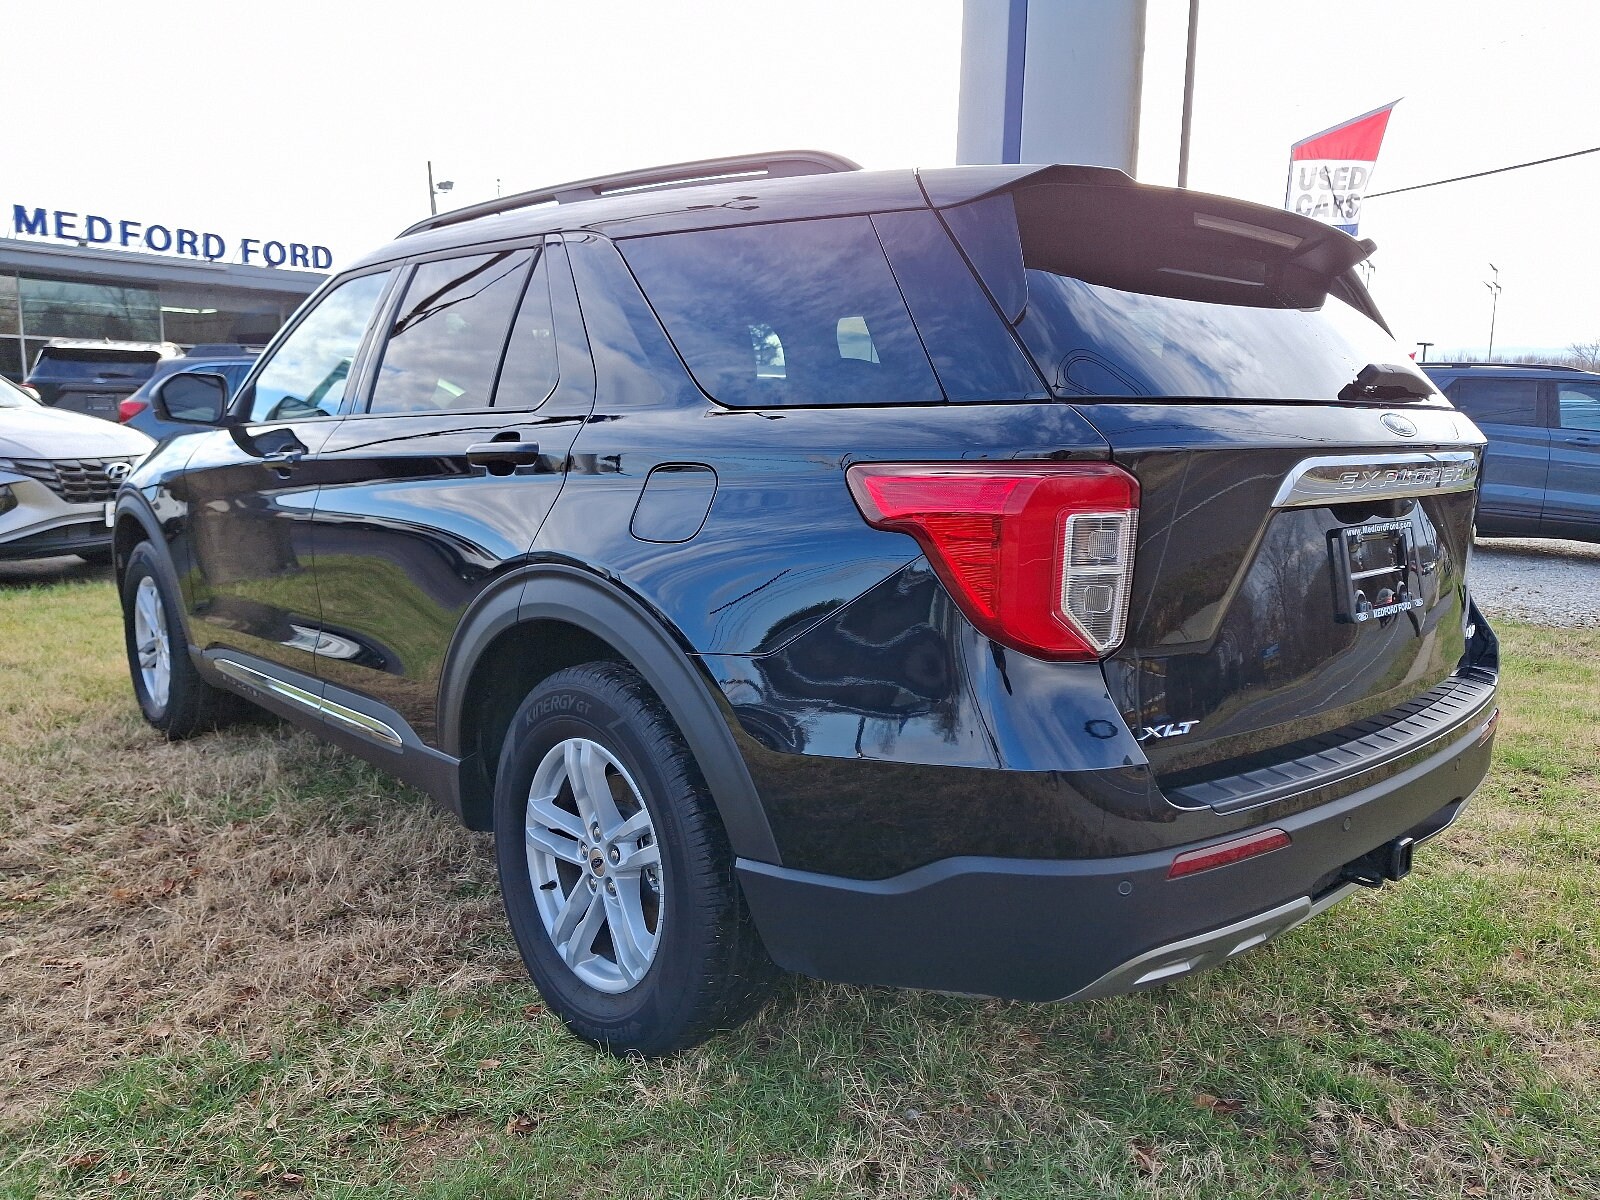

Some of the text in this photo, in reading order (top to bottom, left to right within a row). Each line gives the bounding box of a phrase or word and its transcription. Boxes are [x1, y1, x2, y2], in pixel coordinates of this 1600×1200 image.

[1299, 166, 1367, 191] USED
[1296, 193, 1361, 218] CARS
[13, 204, 333, 269] MEDFORD FORD
[1373, 605, 1399, 618] MEDFORD
[1398, 602, 1412, 612] FORD
[576, 700, 592, 716] GT
[1137, 719, 1200, 741] XLT
